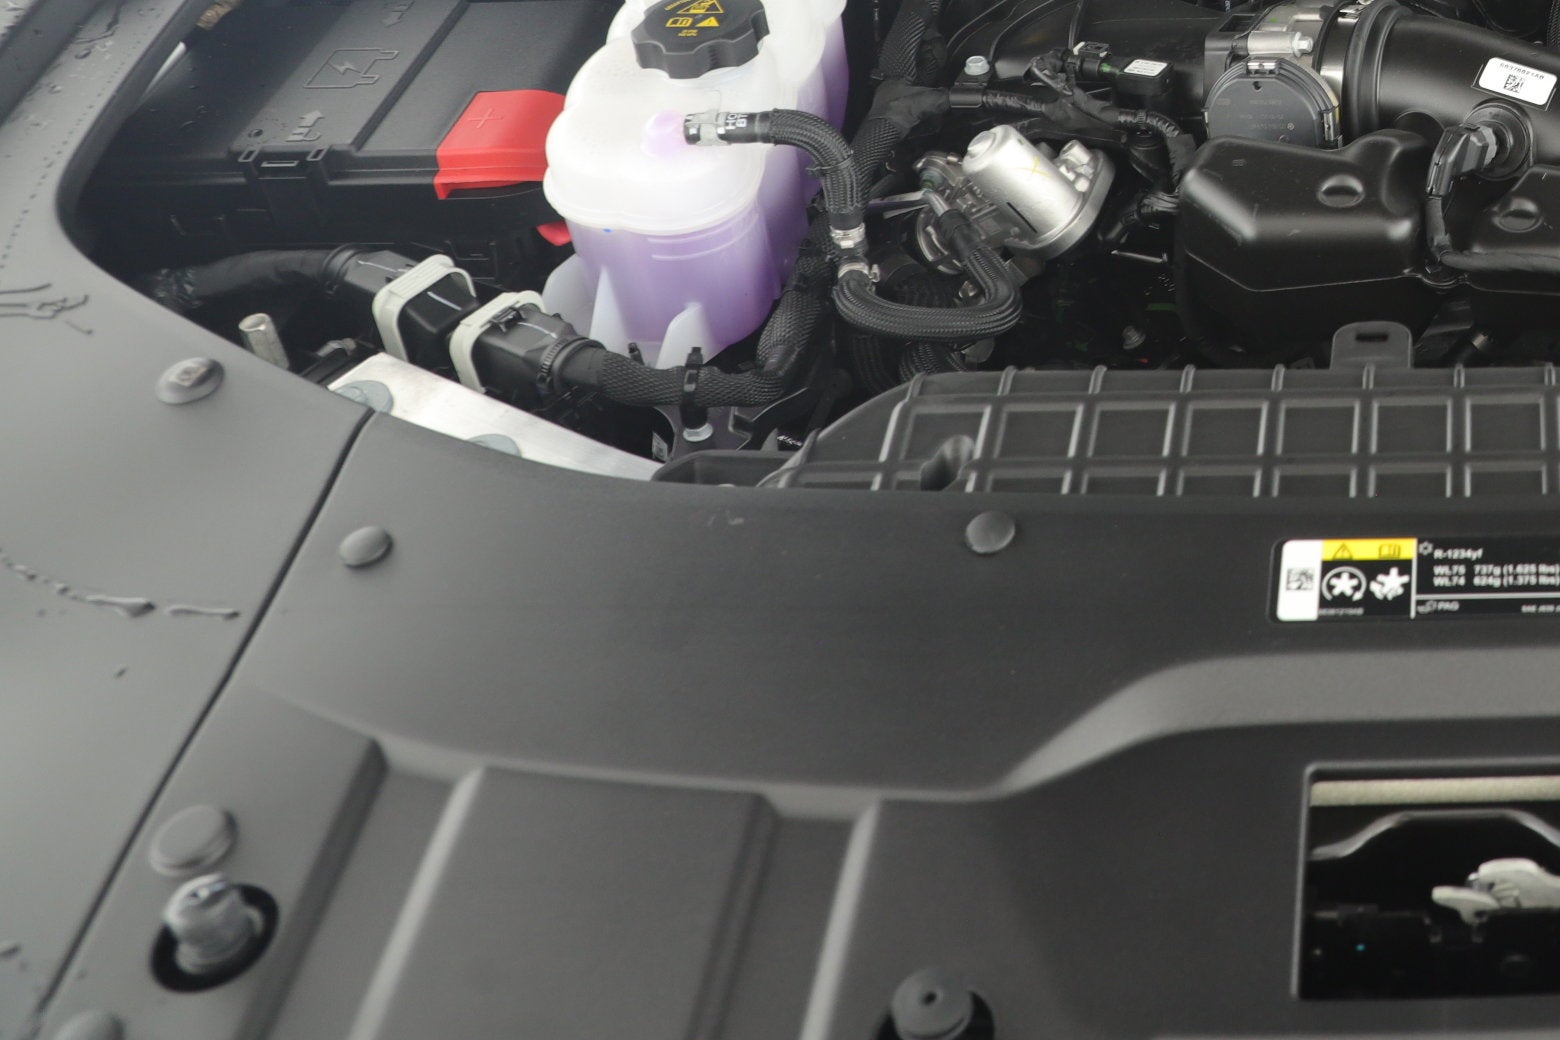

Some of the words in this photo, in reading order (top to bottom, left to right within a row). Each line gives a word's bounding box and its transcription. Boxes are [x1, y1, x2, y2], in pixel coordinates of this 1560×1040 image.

[1433, 546, 1484, 561] R-1234yf
[1473, 564, 1501, 576] 737g
[1503, 563, 1537, 576] (1.625
[1538, 563, 1560, 576] lbs)
[1432, 575, 1466, 587] WL74
[1473, 576, 1501, 588] 624g
[1503, 575, 1537, 587] (1.375
[1538, 575, 1560, 587] lbs)
